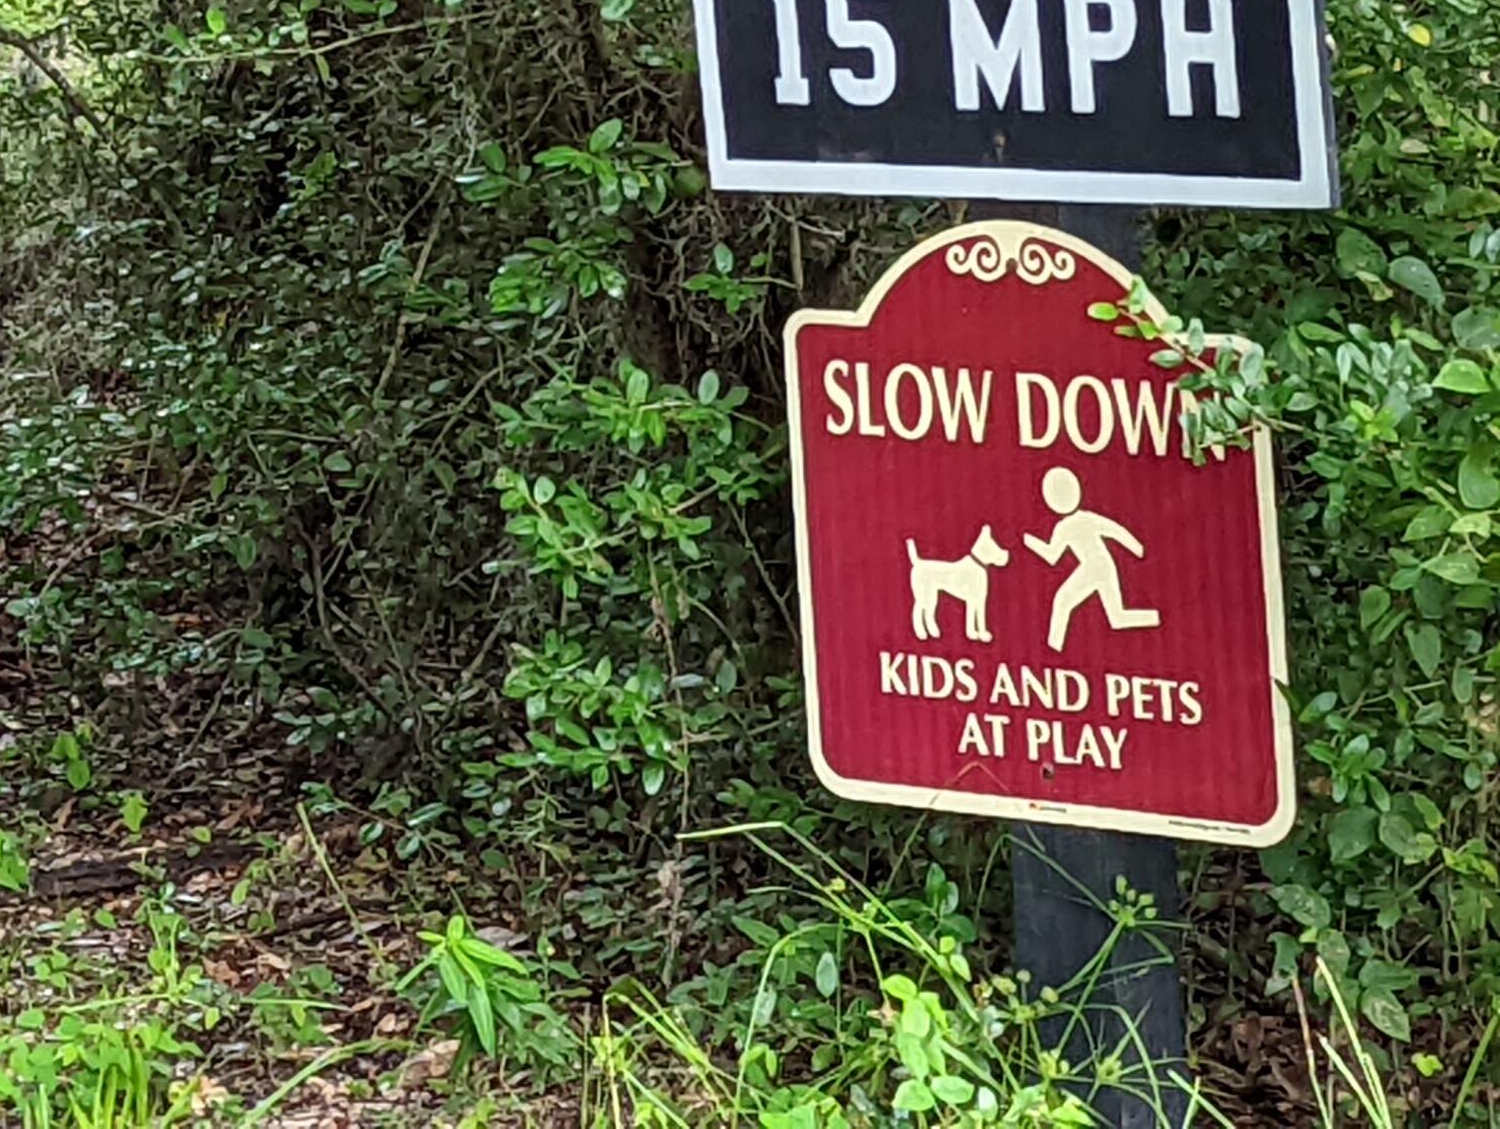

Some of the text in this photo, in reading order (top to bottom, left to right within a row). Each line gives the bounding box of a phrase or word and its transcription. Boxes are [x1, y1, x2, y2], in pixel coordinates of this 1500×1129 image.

[822, 359, 994, 444] SLOW
[878, 650, 1203, 725] KIDS AND PETS
[957, 712, 1129, 770] AT PLAY
